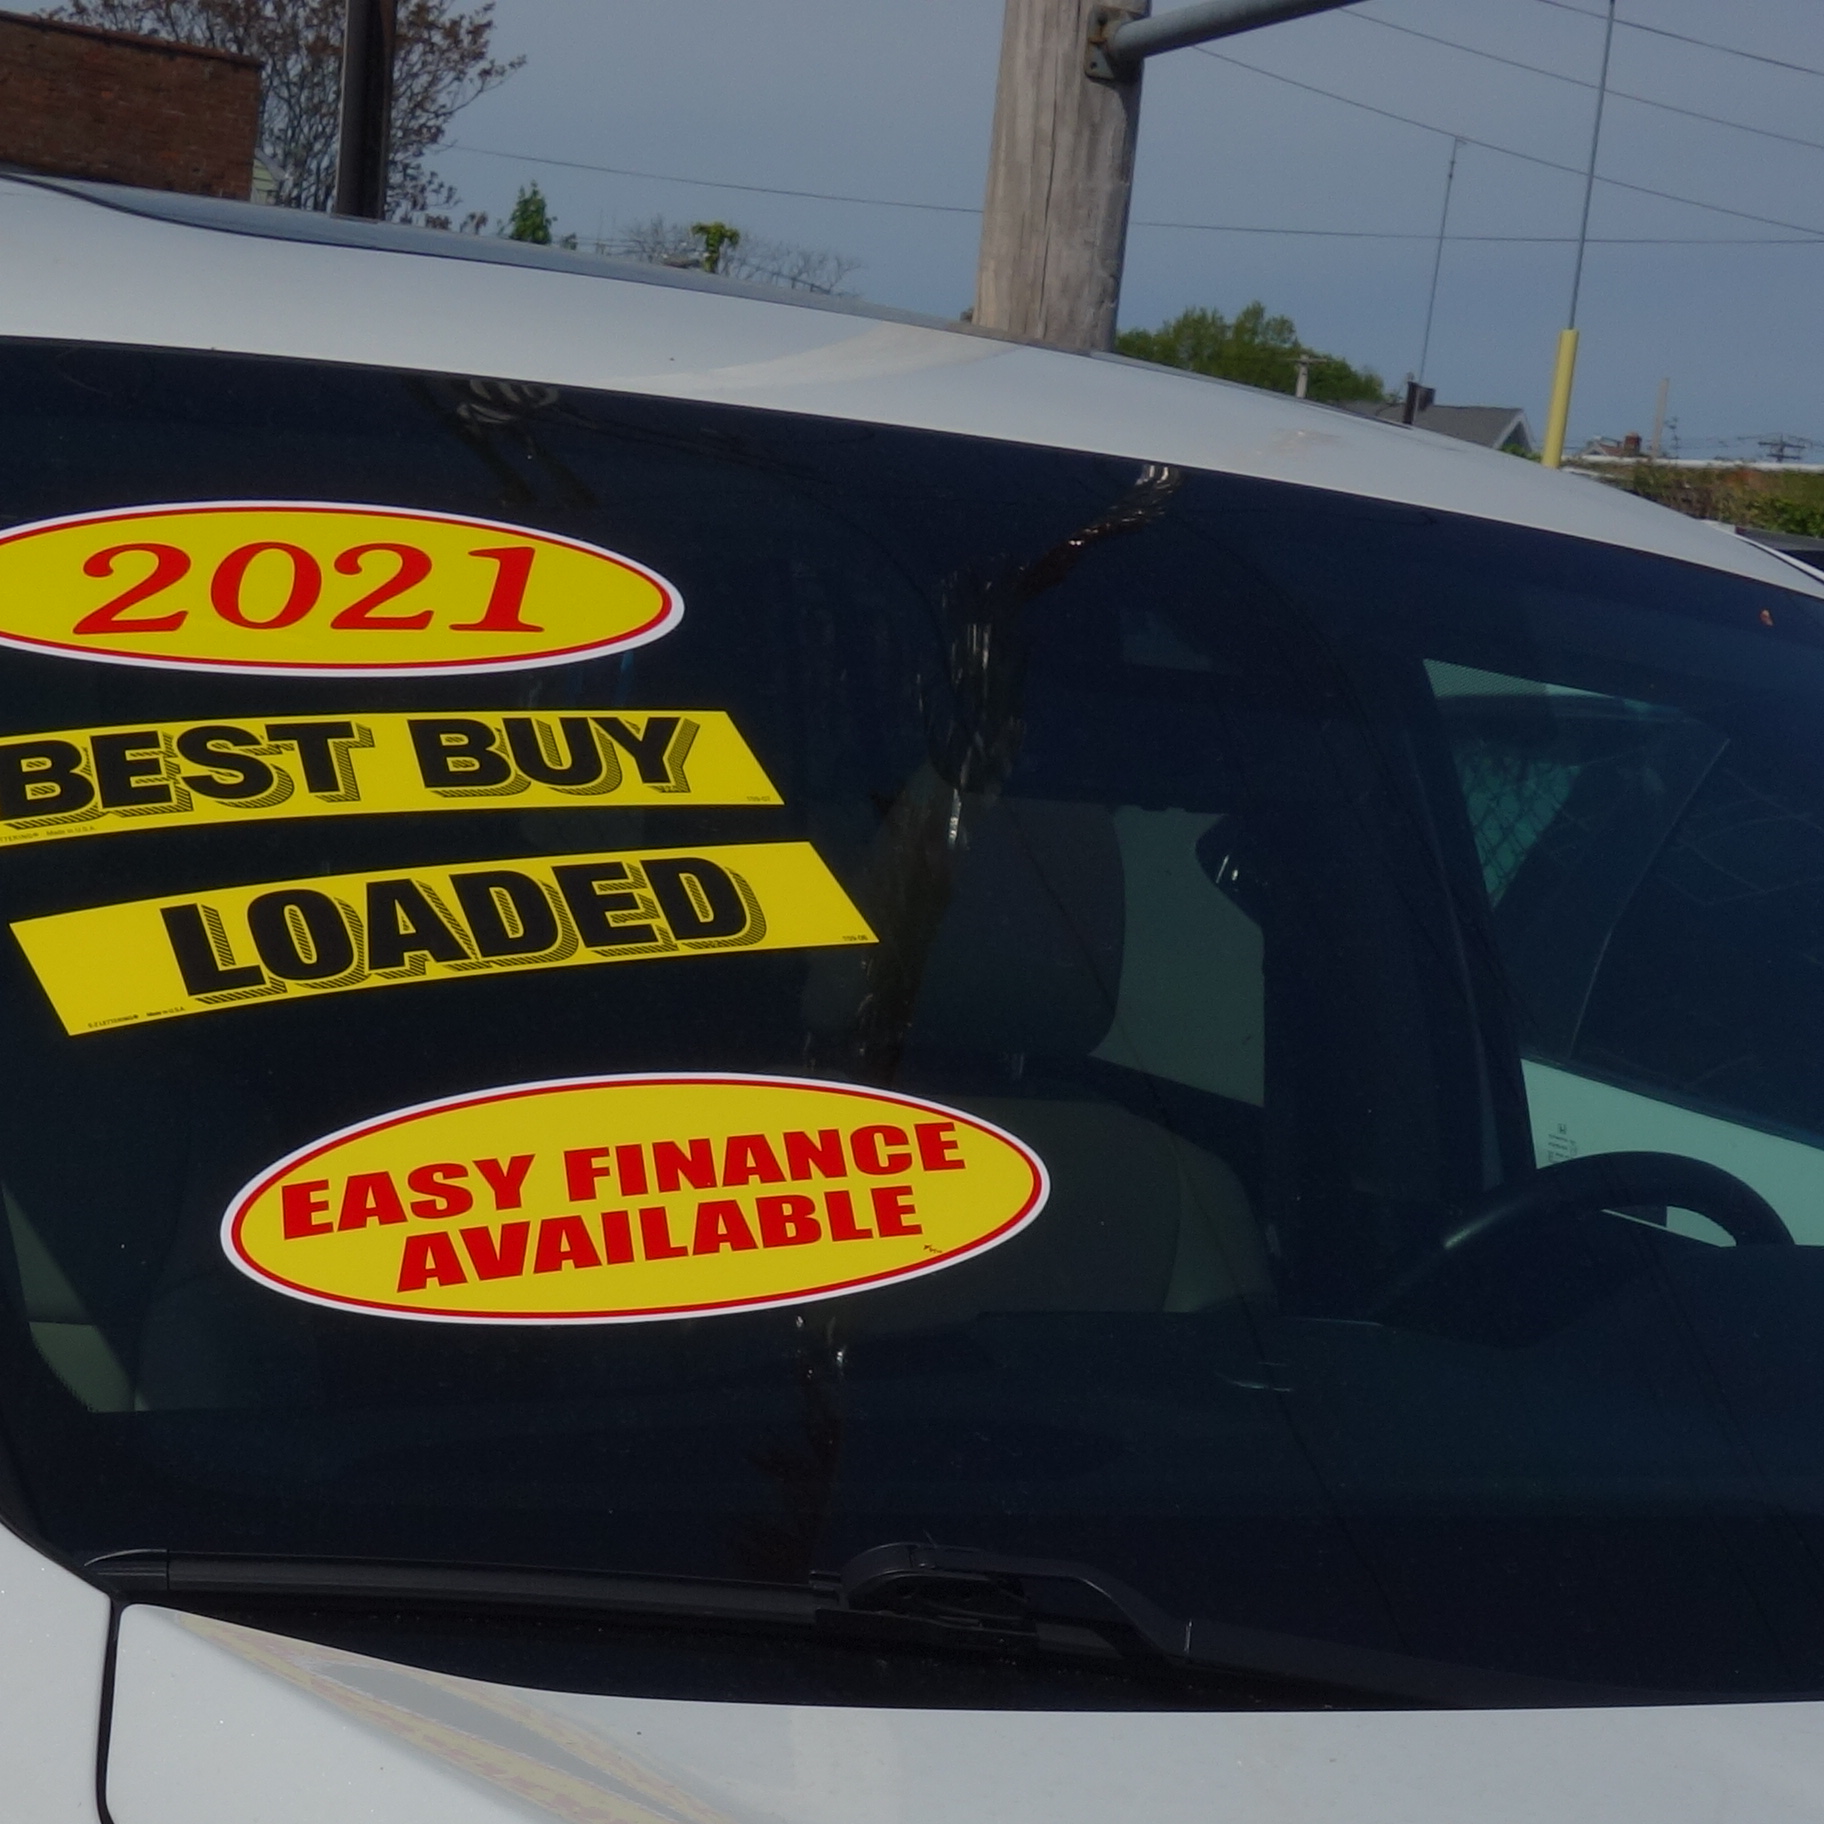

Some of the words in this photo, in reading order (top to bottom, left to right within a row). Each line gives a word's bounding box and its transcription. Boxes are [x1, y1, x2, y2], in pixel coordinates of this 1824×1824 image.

[72, 541, 545, 635] 2021
[406, 716, 701, 798] BUY
[160, 856, 767, 1005] LOADED
[280, 1154, 536, 1239] EASY
[560, 1121, 966, 1204] FINANCE
[396, 1185, 923, 1293] AVAILABLE
